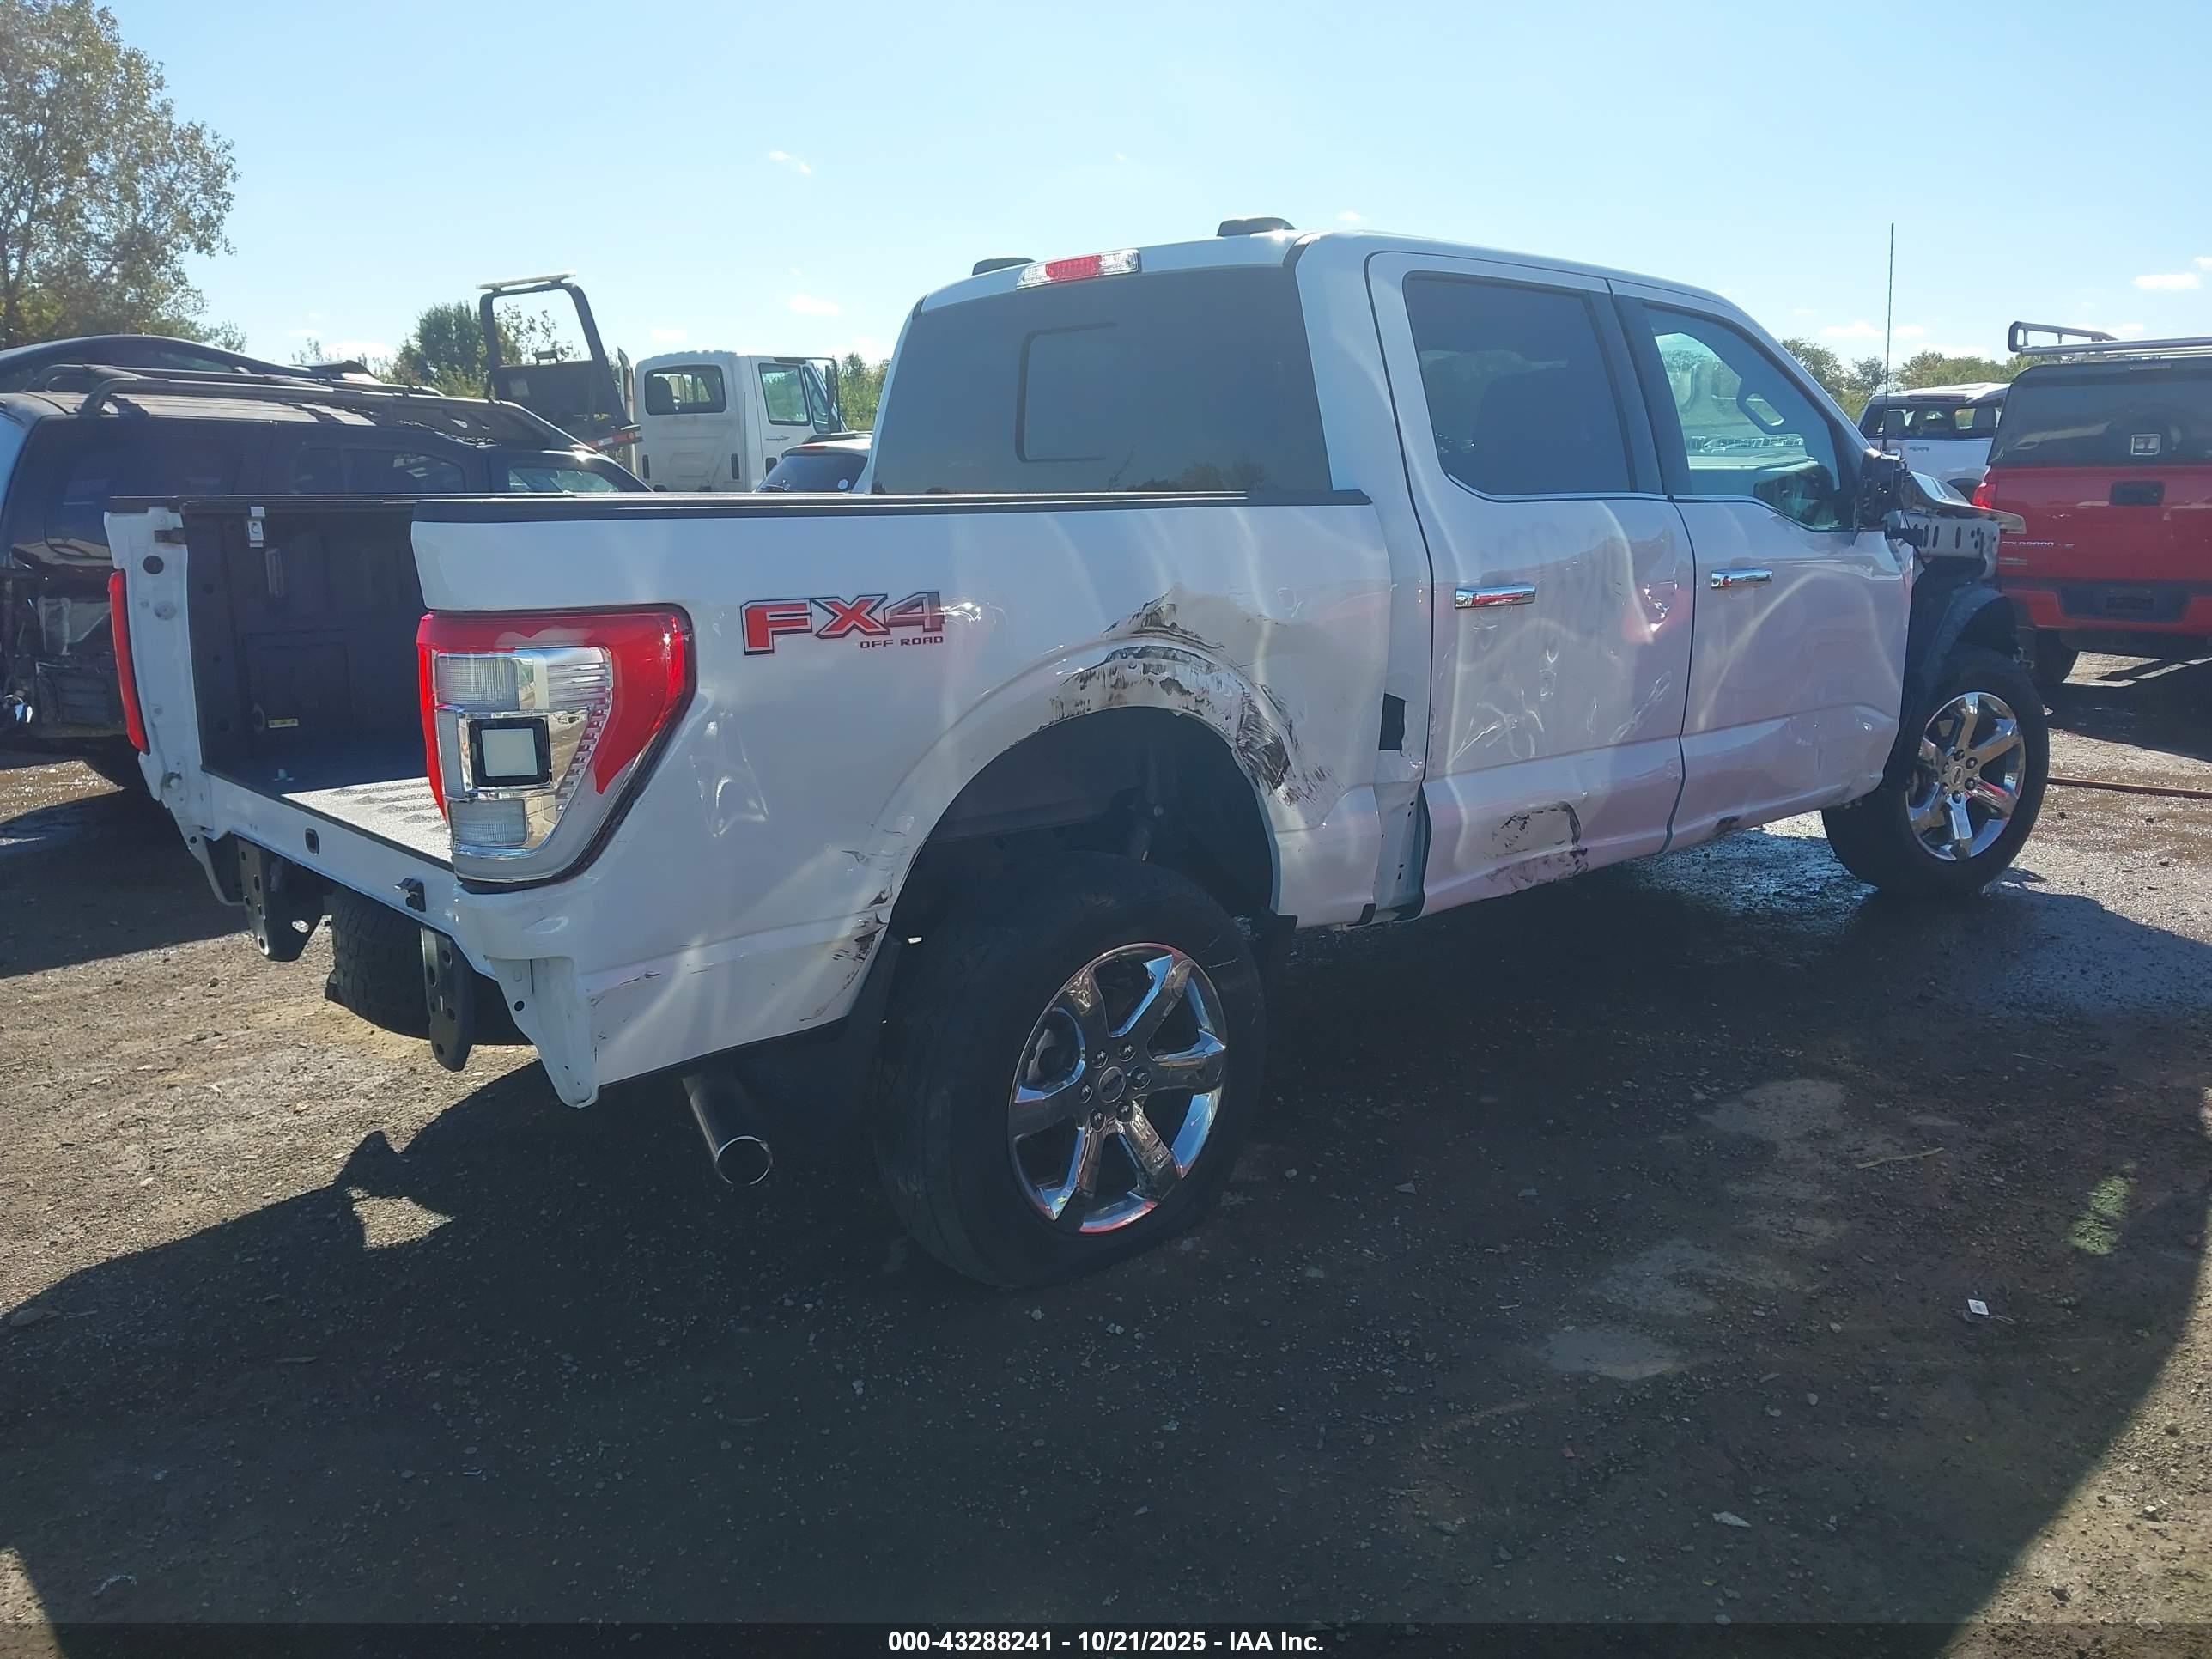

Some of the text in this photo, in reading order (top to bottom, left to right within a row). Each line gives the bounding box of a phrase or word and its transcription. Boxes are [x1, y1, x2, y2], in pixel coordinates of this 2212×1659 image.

[740, 591, 945, 655] FX4
[860, 635, 943, 649] OFF ROAD
